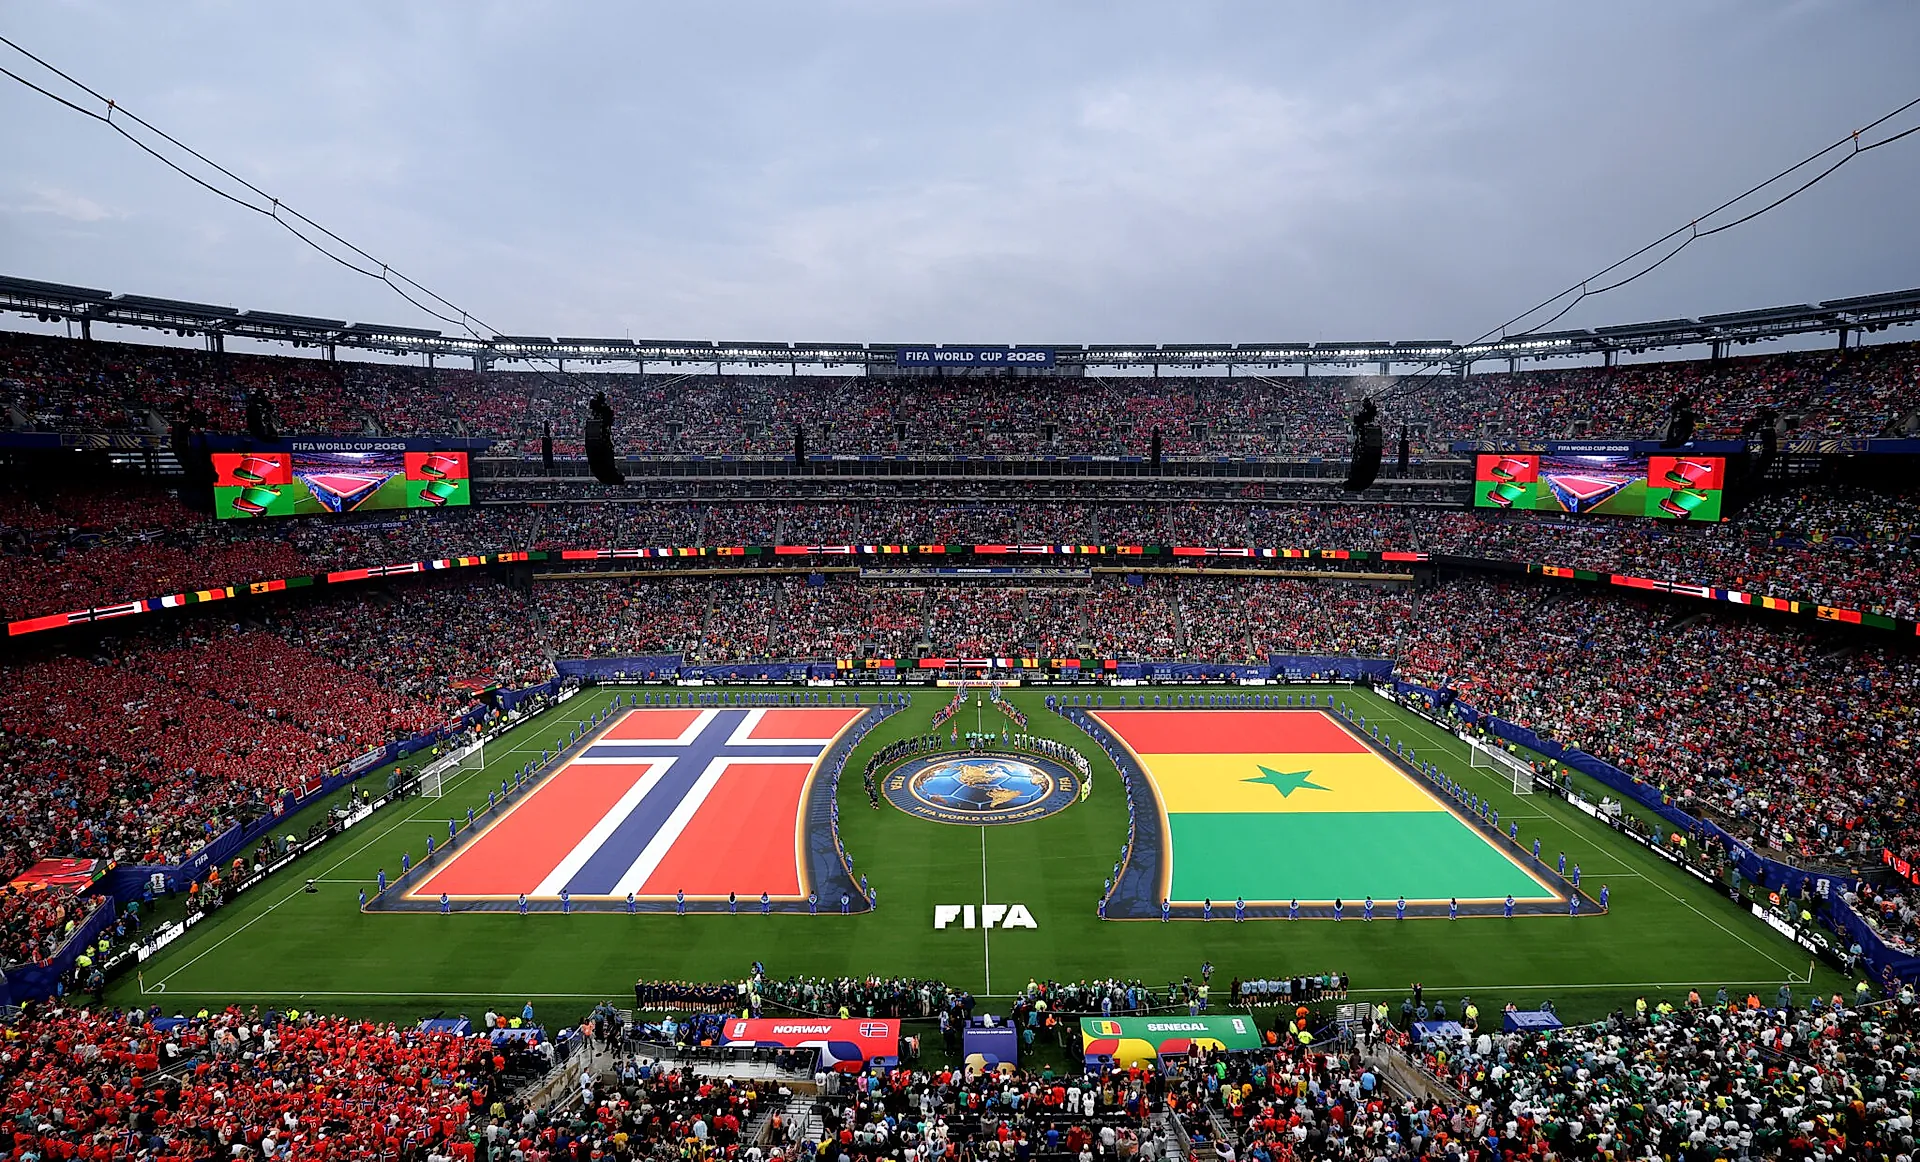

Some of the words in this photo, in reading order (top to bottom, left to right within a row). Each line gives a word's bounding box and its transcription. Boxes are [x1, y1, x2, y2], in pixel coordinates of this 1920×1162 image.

[905, 351, 929, 361] FIFA
[934, 351, 974, 361] WORLD
[980, 352, 1002, 361] CUP
[1006, 352, 1046, 361] 2026
[914, 806, 937, 817] FIFA
[938, 813, 980, 821] WORLD
[1007, 807, 1046, 819] 2026
[194, 853, 208, 868] FIFA
[934, 904, 1038, 929] FIFA
[137, 944, 150, 962] NO
[155, 921, 184, 950] RACISM
[186, 910, 205, 928] FIFA
[1797, 934, 1818, 954] FIFA
[772, 1025, 832, 1034] NORWAY
[1147, 1022, 1209, 1031] SENEGAL
